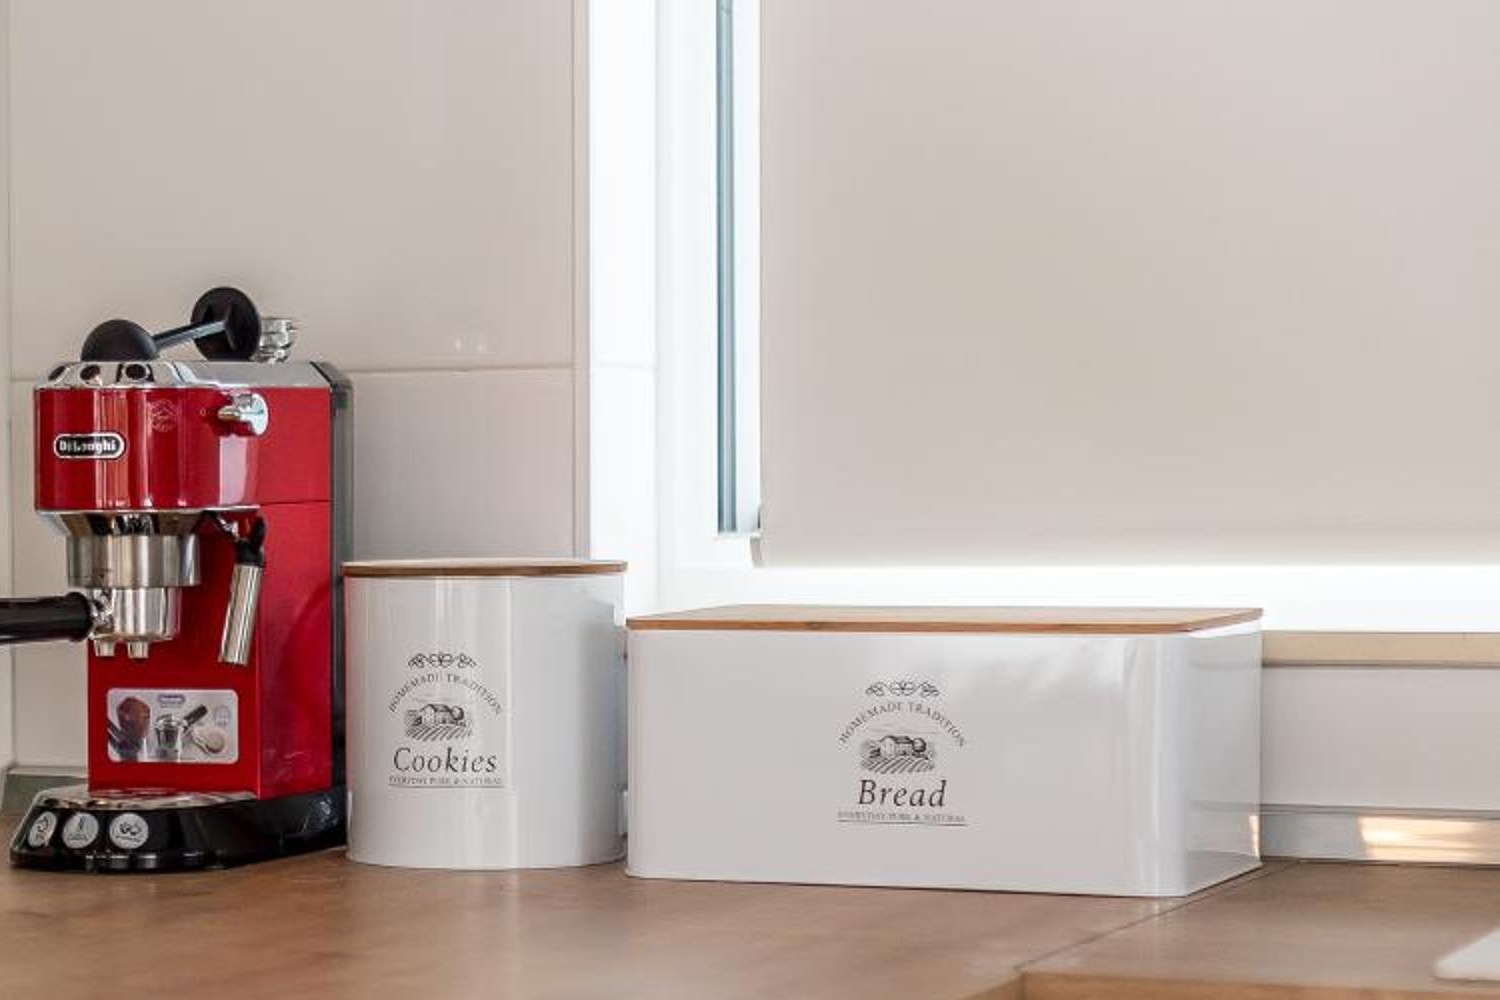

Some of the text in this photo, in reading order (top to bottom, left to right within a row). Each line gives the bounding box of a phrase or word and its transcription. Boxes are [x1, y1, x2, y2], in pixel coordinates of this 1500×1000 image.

[447, 673, 502, 715] TRADITION
[839, 702, 965, 747] HOMEMADE TRADITION
[393, 747, 498, 773] Cookies
[857, 779, 948, 808] Bread
